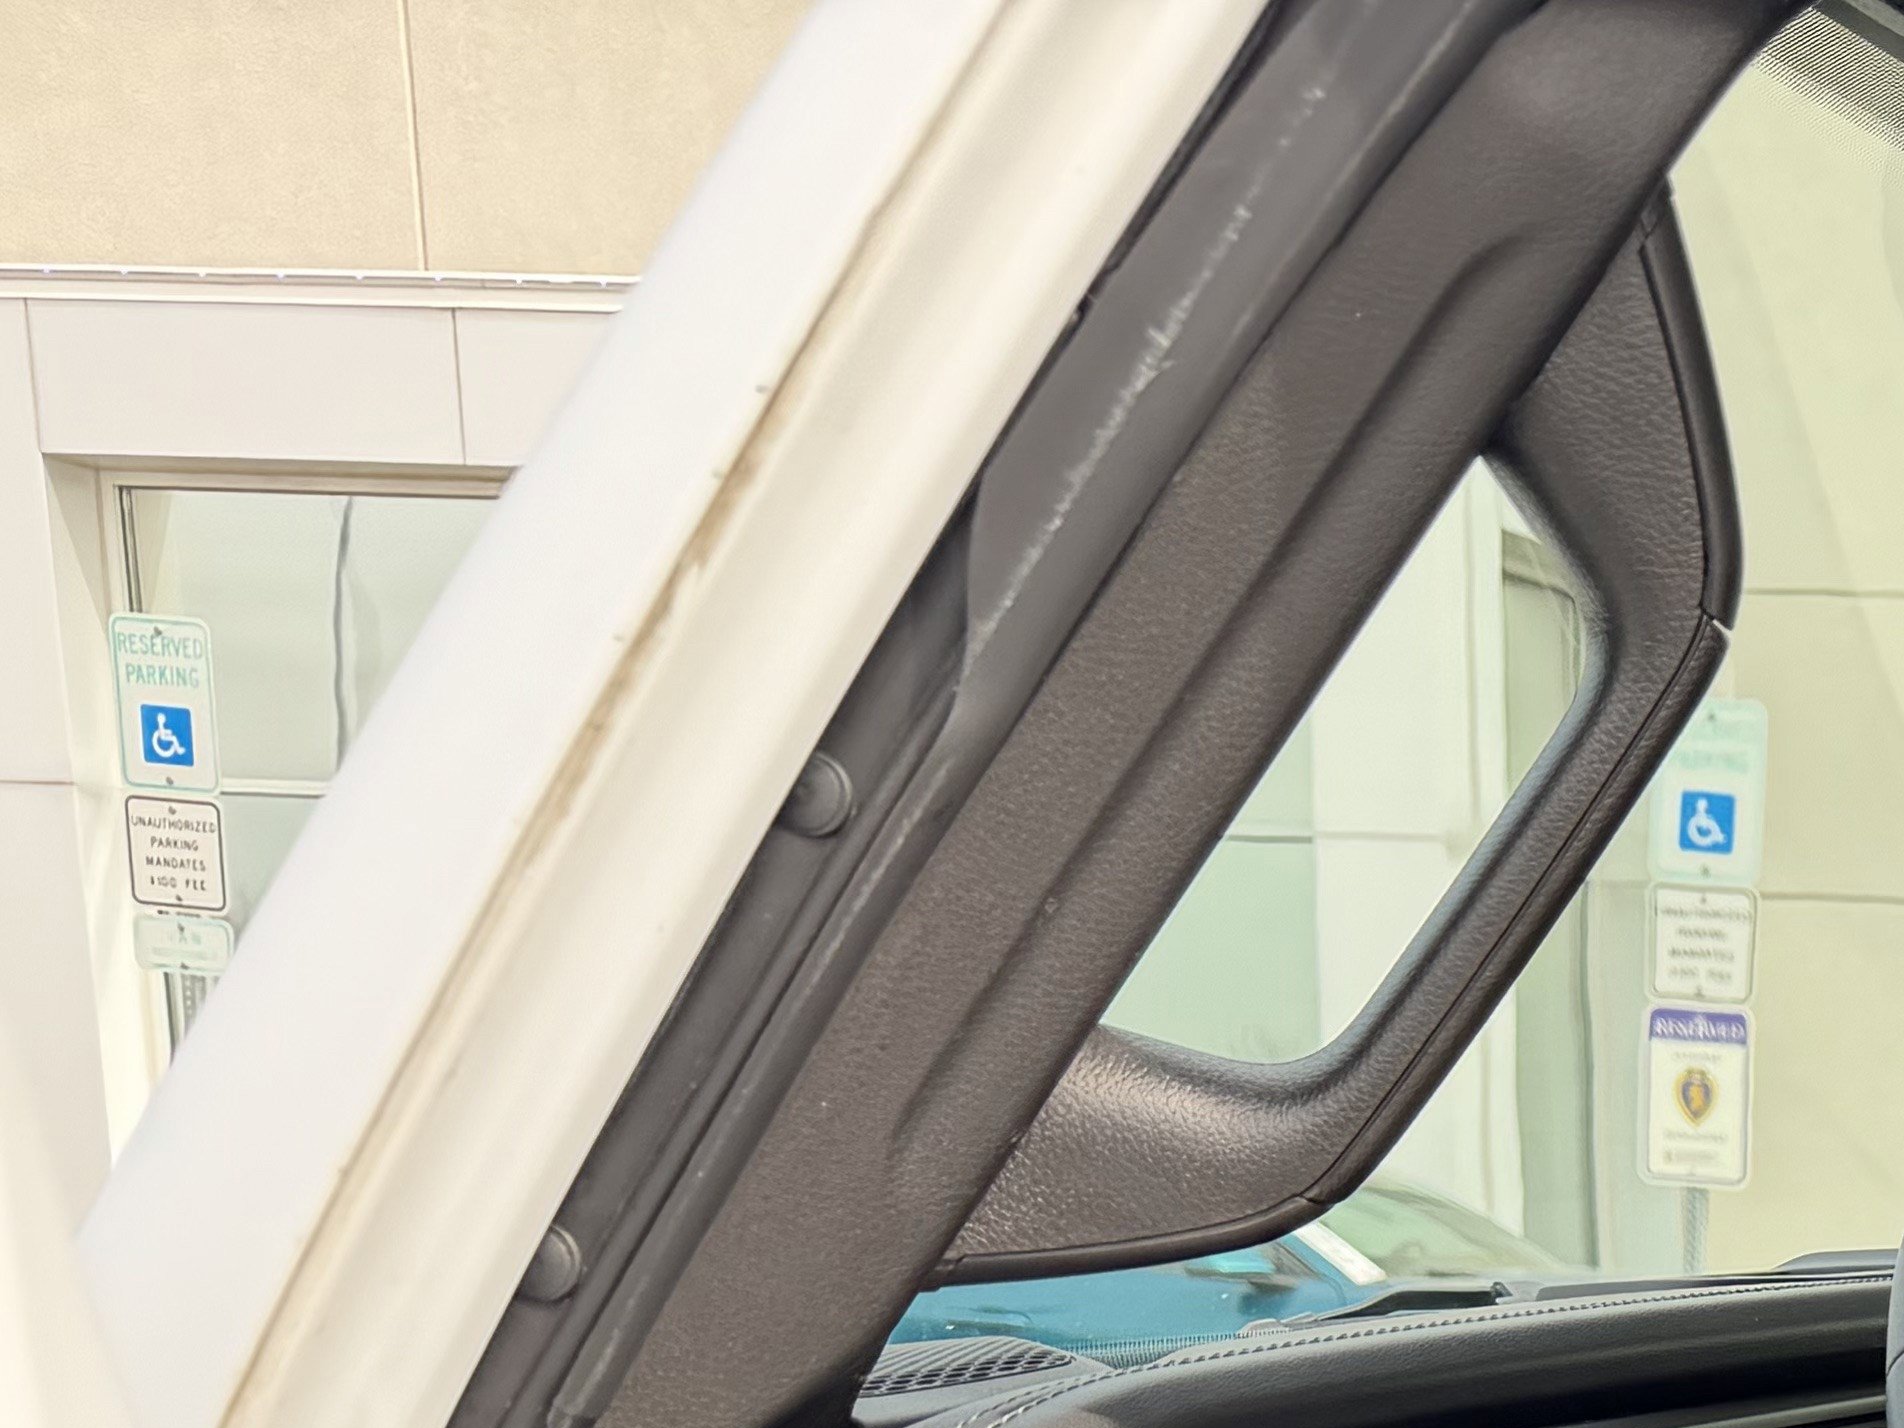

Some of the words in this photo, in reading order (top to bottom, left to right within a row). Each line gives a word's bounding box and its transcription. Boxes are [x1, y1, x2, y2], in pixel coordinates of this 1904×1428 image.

[117, 632, 203, 660] RESERVED
[125, 665, 200, 688] PARKING
[131, 815, 216, 833] UNAUTHORIZED
[150, 836, 199, 851] PARKING
[145, 856, 206, 872] MANDATES
